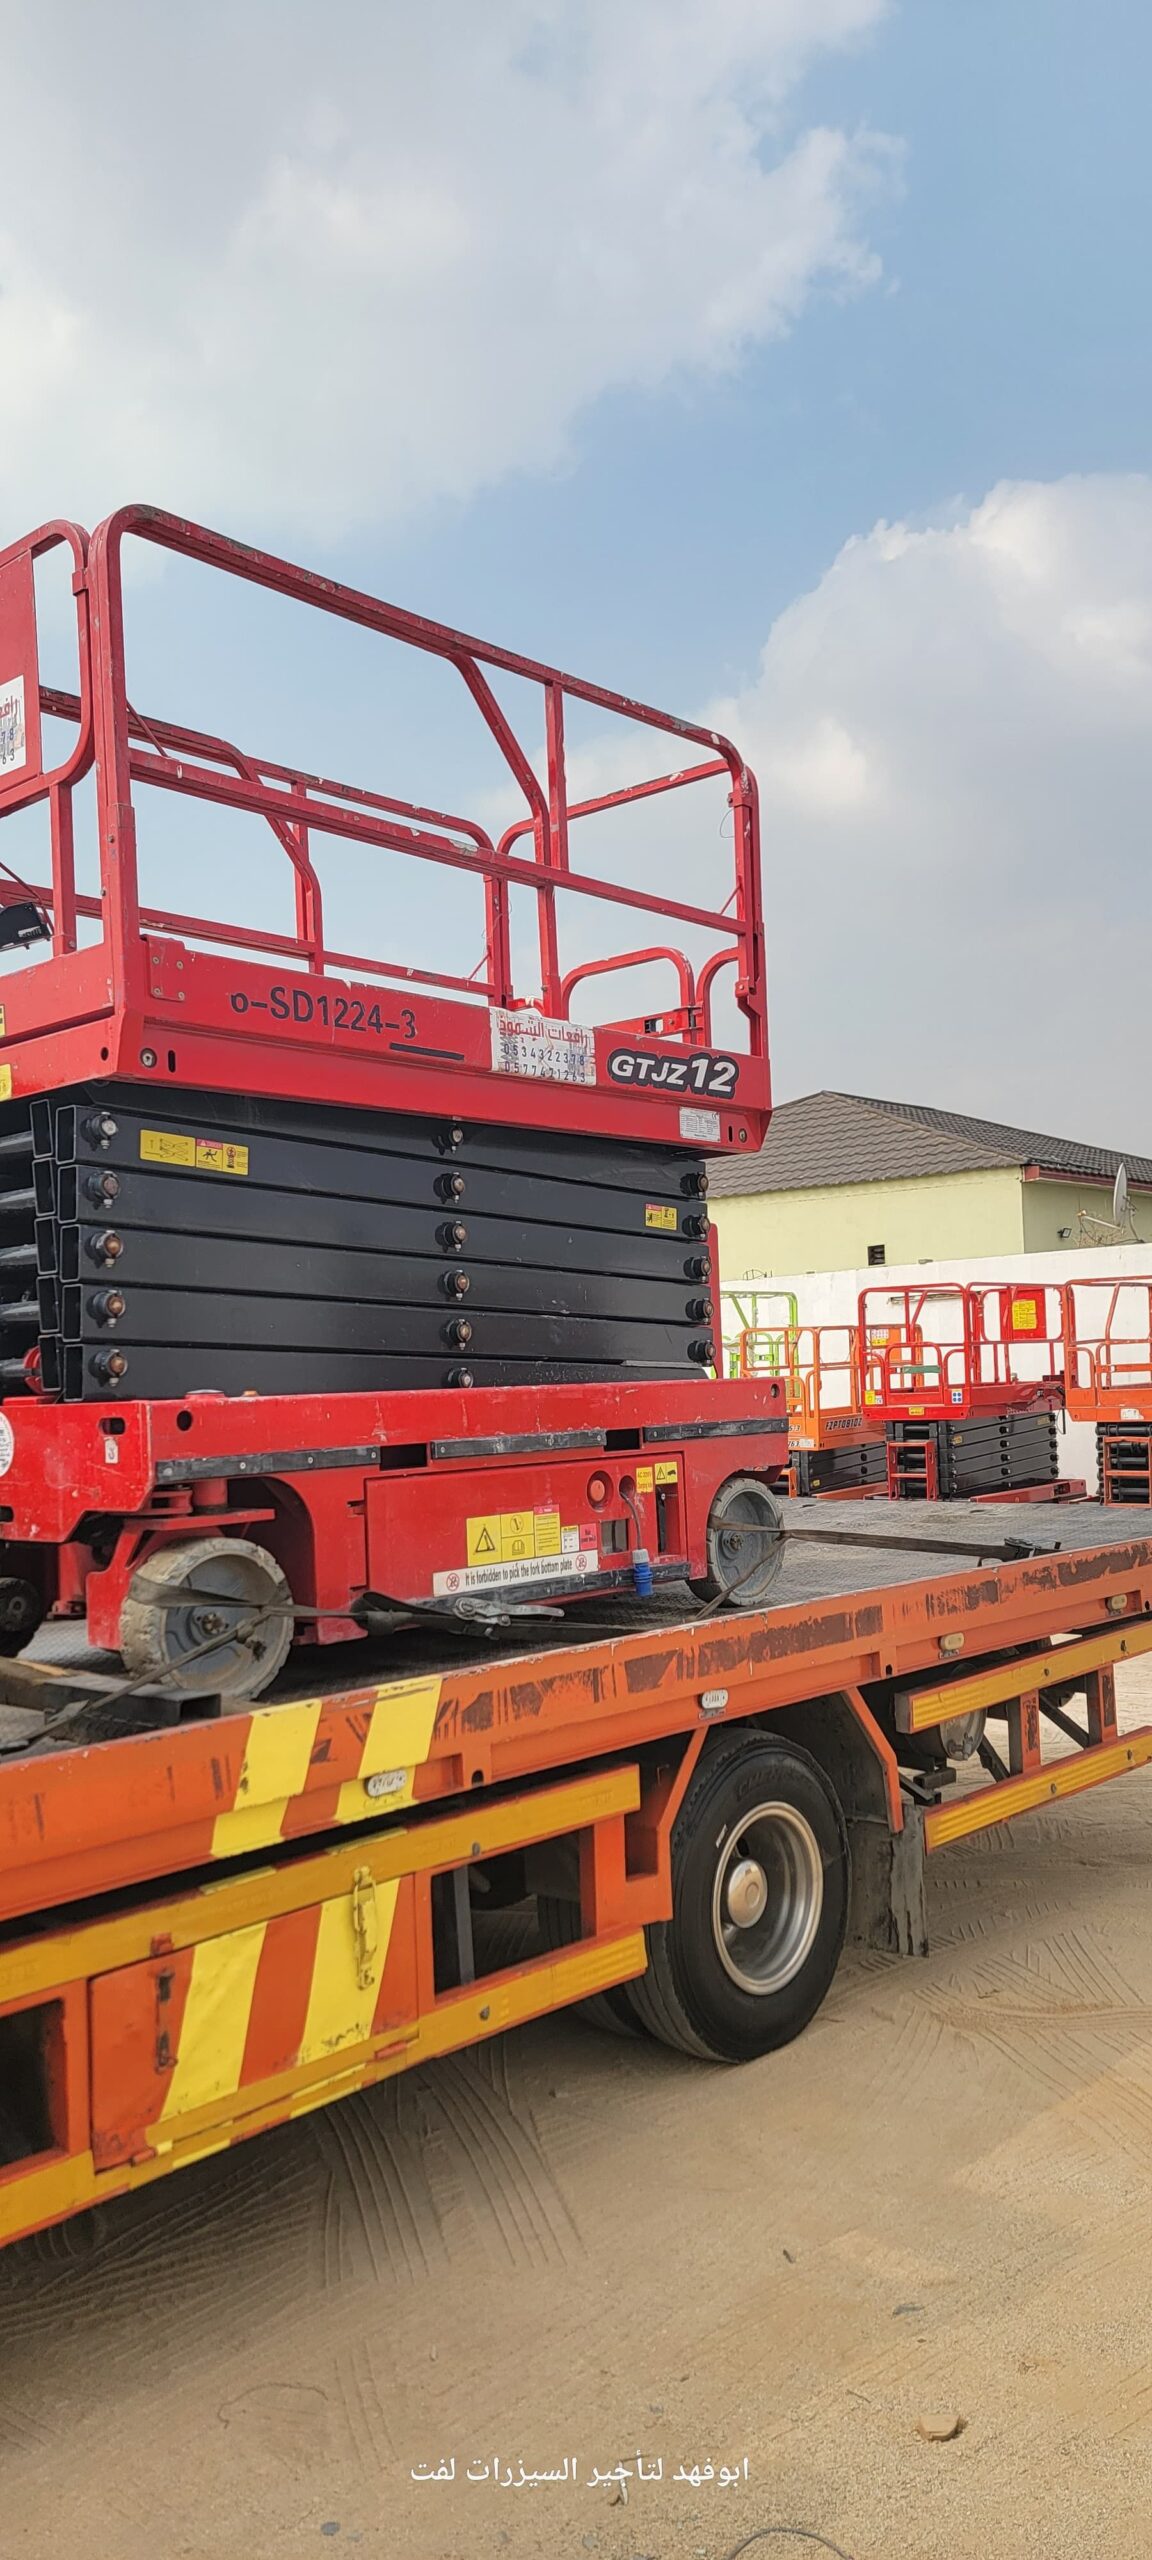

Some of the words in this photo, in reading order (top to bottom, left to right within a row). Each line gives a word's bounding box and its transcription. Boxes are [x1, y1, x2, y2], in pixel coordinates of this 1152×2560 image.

[465, 1571, 470, 1586] It
[470, 1570, 475, 1585] is
[476, 1566, 501, 1584] forbidden
[502, 1567, 508, 1580] to
[509, 1563, 520, 1582] pick
[520, 1562, 529, 1577] the
[530, 1562, 541, 1577] fork
[541, 1559, 559, 1574] bottom
[560, 1557, 573, 1575] plate
